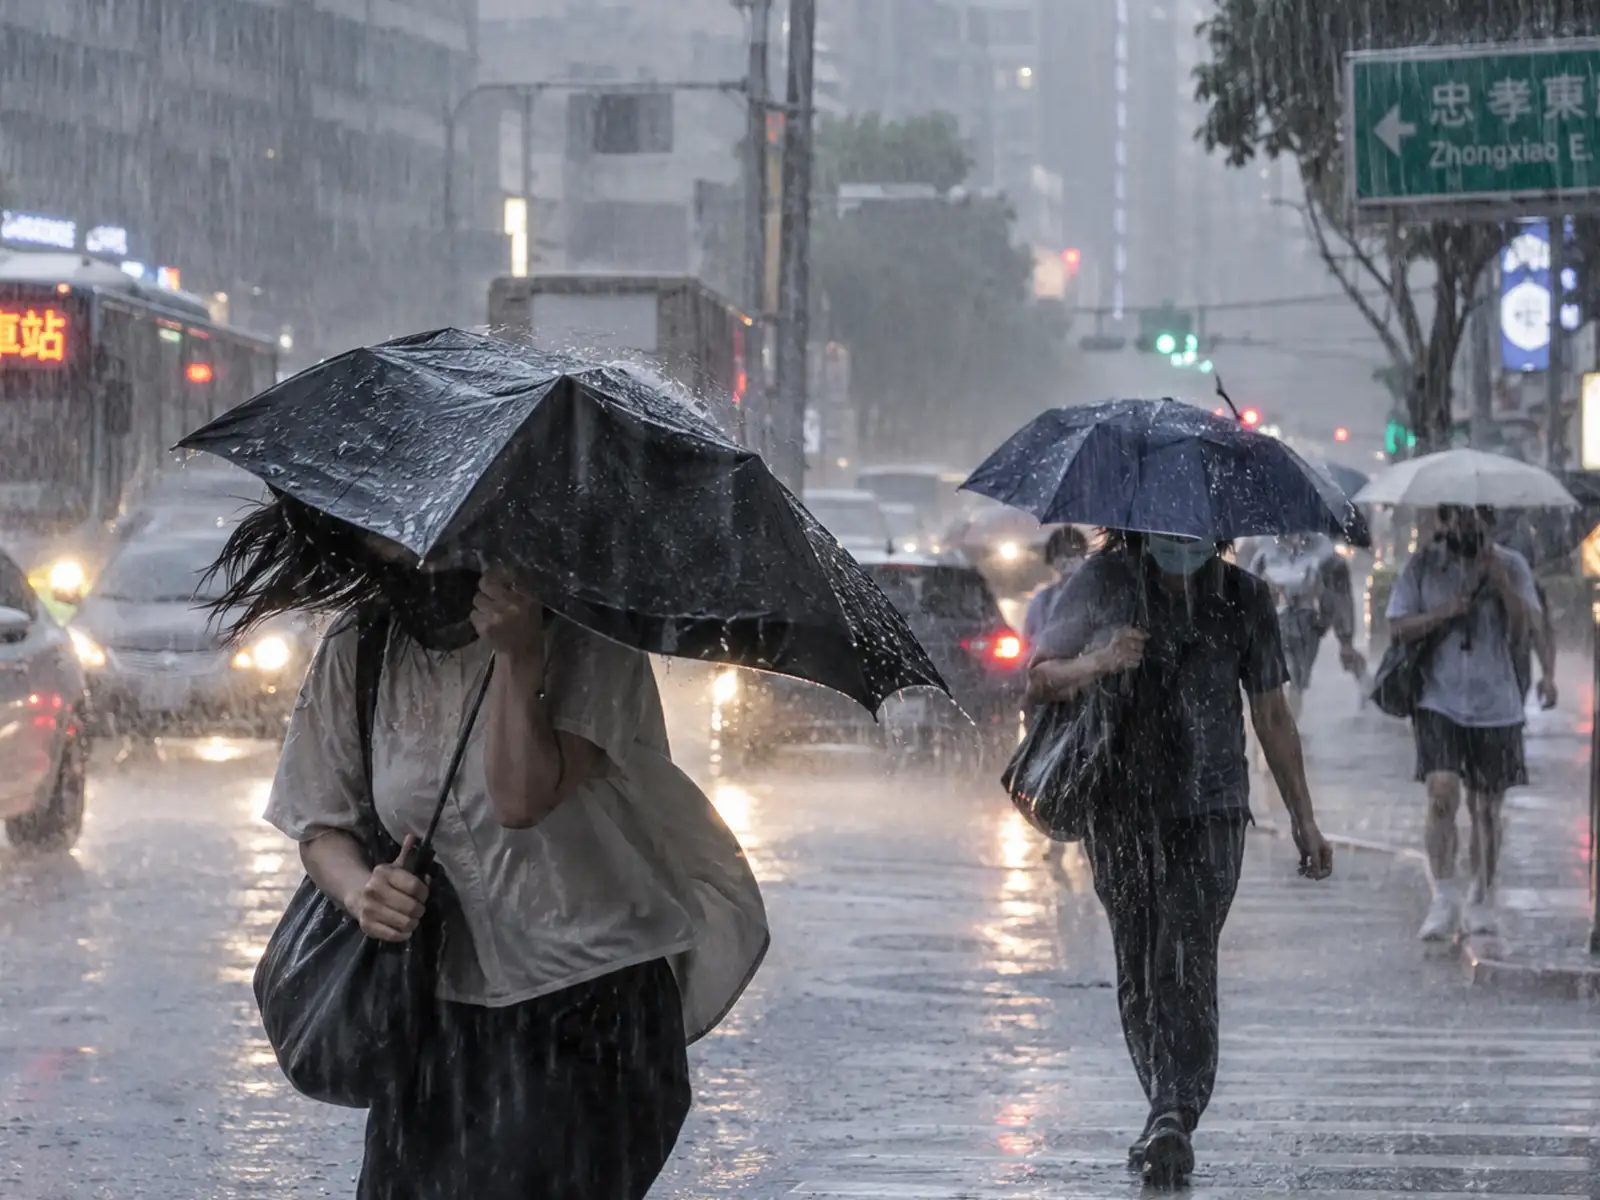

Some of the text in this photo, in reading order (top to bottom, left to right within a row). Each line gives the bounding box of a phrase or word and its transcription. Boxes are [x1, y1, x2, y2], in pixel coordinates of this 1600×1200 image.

[1430, 73, 1600, 126] 忠孝東
[1429, 133, 1593, 171] Zhongxiao E.
